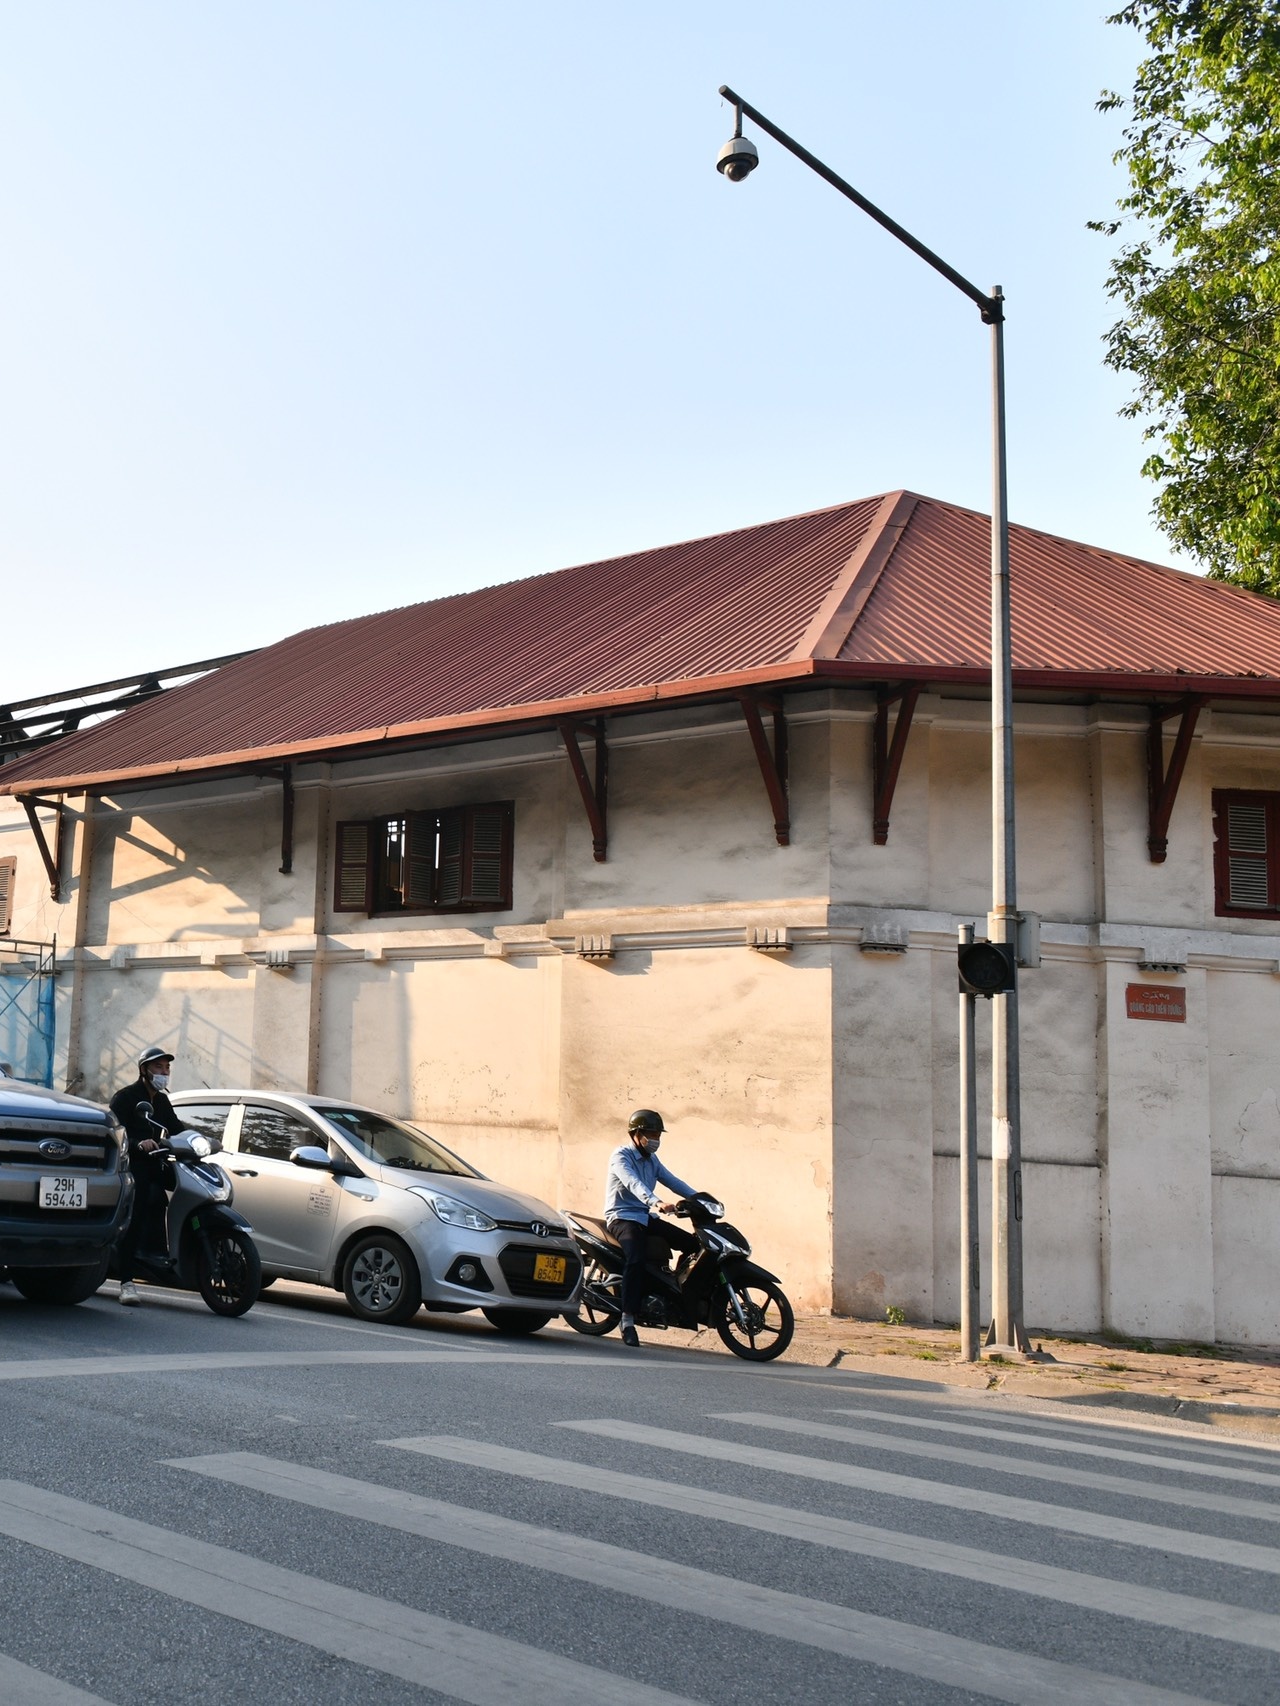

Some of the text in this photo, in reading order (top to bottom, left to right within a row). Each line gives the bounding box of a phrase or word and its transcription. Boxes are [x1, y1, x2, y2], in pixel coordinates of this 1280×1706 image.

[47, 1142, 67, 1154] Ford
[54, 1178, 75, 1192] 29H
[45, 1193, 83, 1207] 594.43
